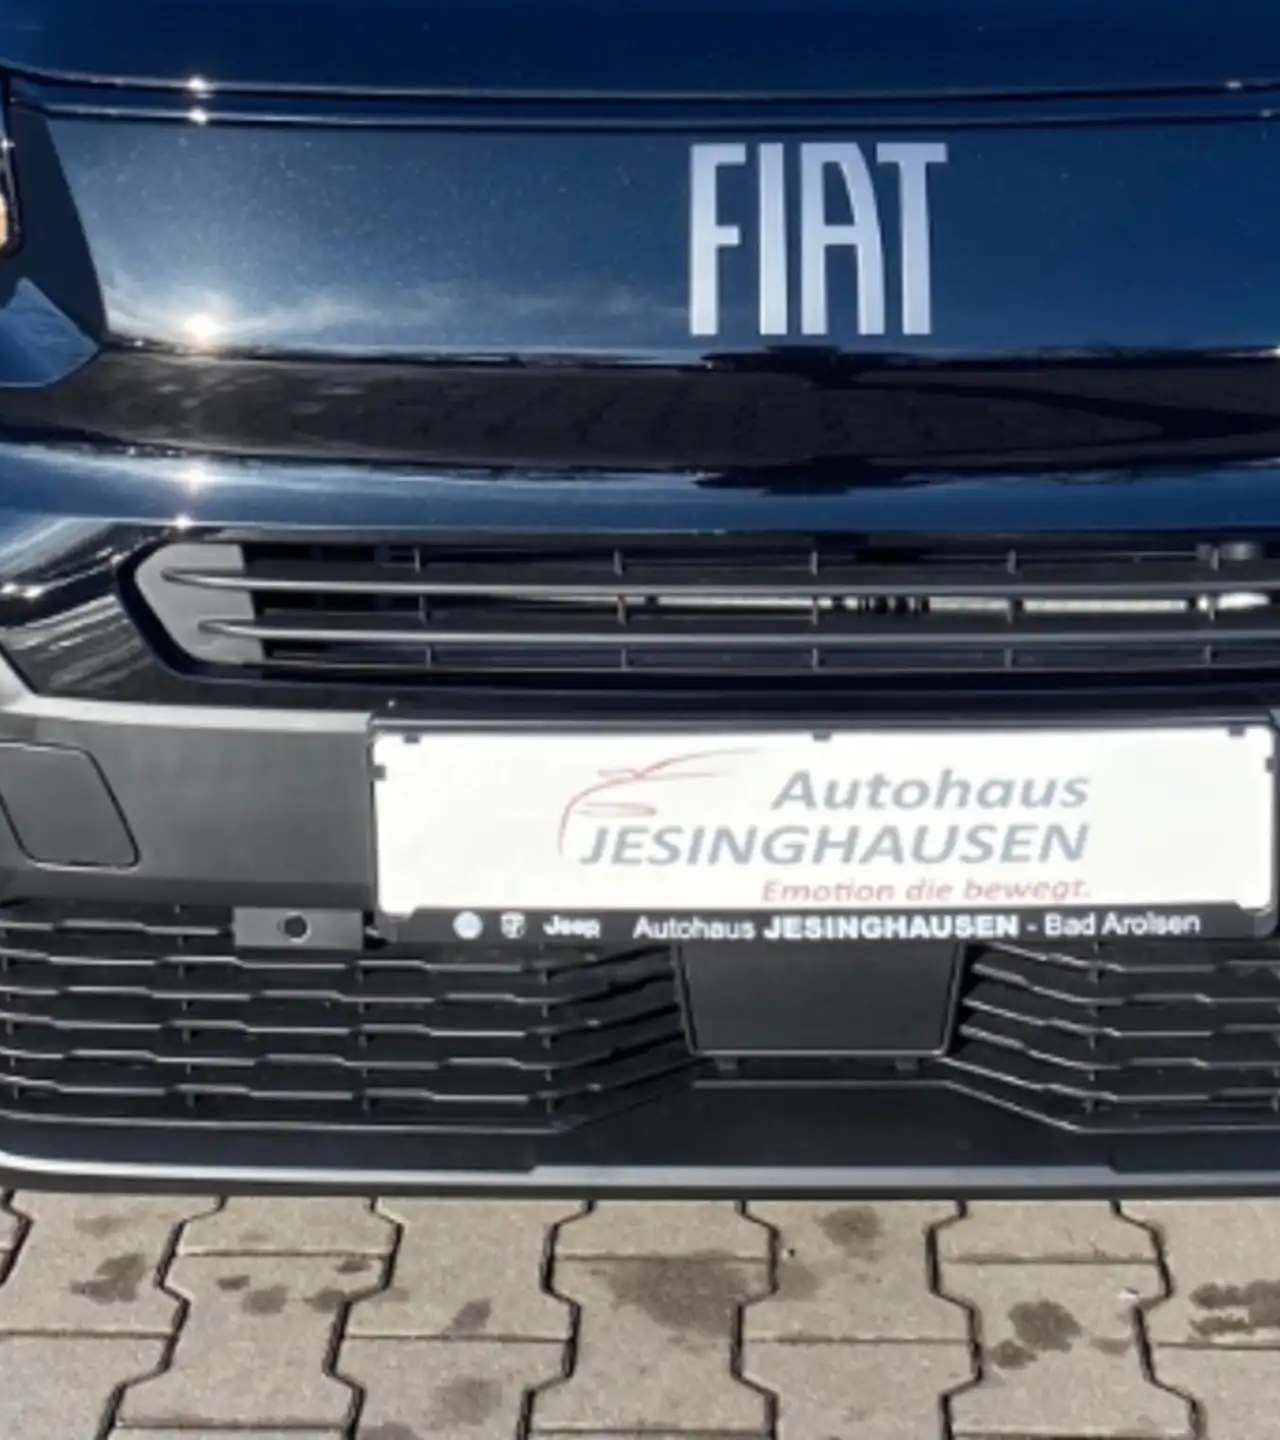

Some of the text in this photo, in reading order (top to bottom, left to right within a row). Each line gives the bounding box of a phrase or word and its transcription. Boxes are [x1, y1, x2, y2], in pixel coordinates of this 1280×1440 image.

[689, 142, 948, 336] FIAT
[770, 768, 1091, 811] Autohaus
[579, 823, 1091, 867] JESINGHAUSEN
[761, 877, 1092, 906] Emotion die bewegt.
[631, 915, 756, 940] Autohaus
[763, 913, 1019, 939] JESINGHAUSEN
[1043, 912, 1095, 937] Bad
[1100, 912, 1202, 937] Arolsen
